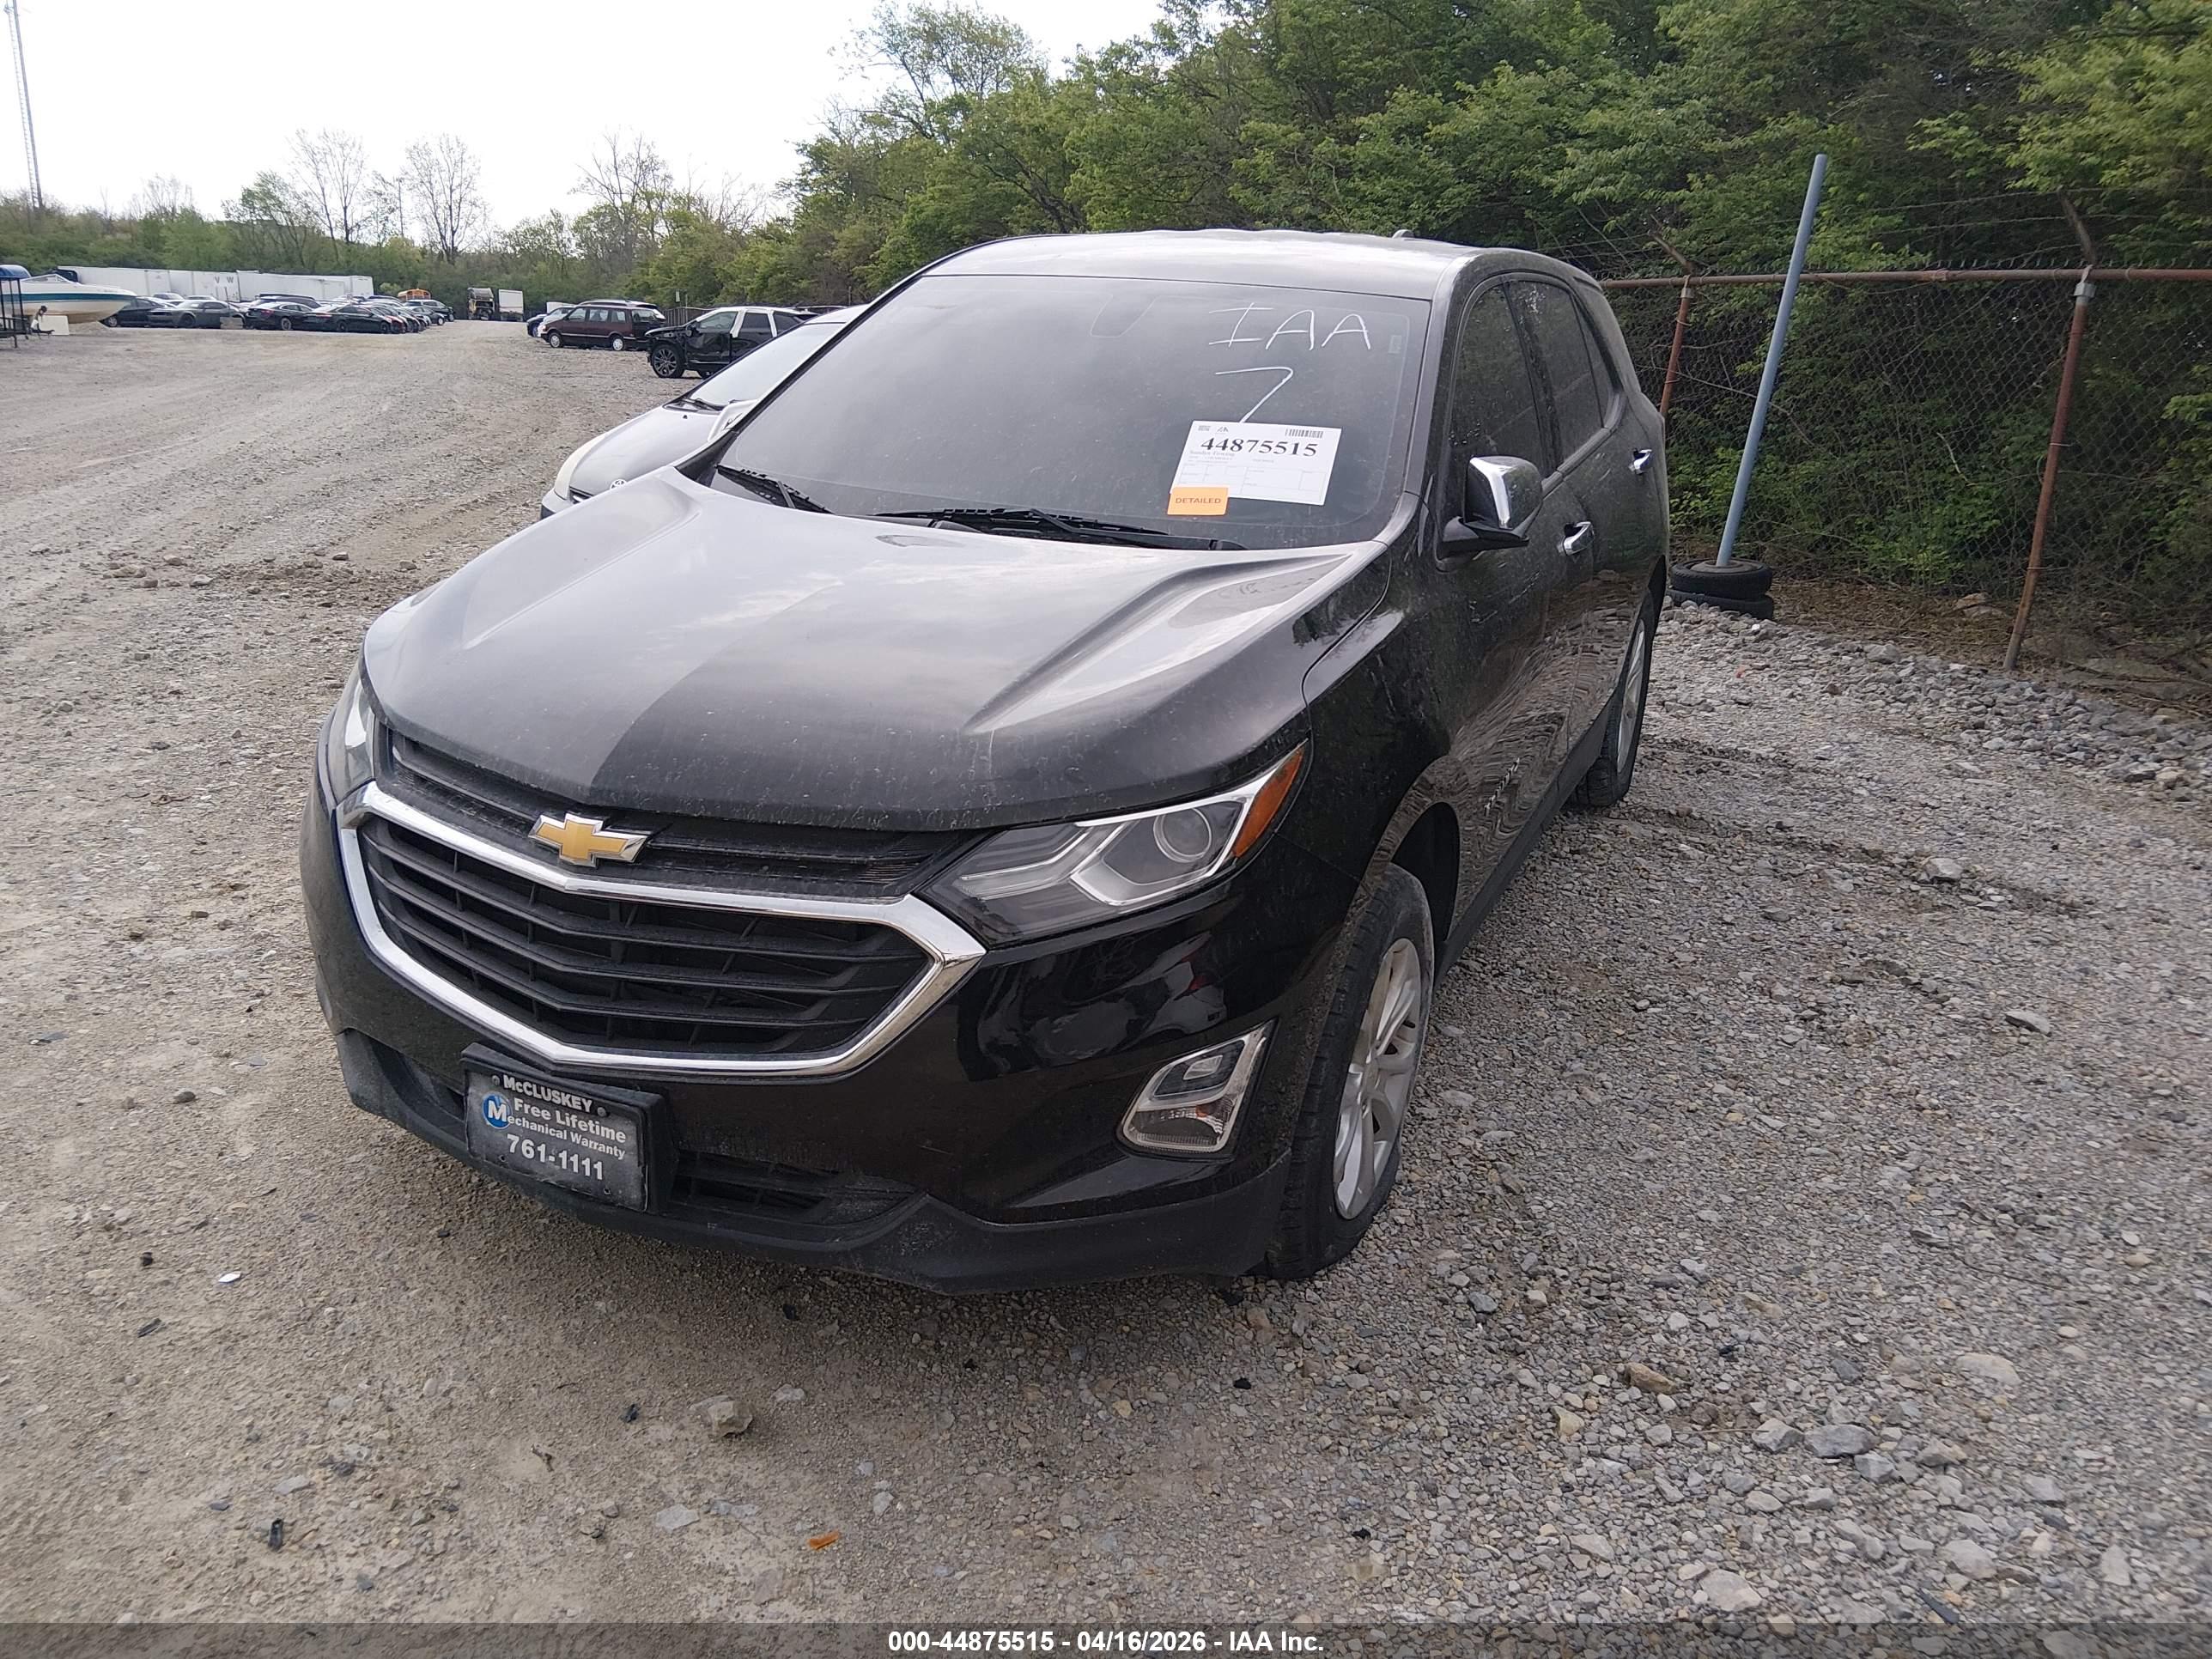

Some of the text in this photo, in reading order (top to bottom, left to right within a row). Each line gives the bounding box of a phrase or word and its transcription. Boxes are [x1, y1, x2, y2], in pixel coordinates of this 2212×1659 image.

[1208, 301, 1371, 350] IAA
[1200, 437, 1319, 457] 44875515
[503, 1074, 592, 1113] McCLUSKEY
[514, 1097, 626, 1143] Free Lifetime
[507, 1133, 603, 1181] 761-1111
[570, 1131, 626, 1160] Warranty
